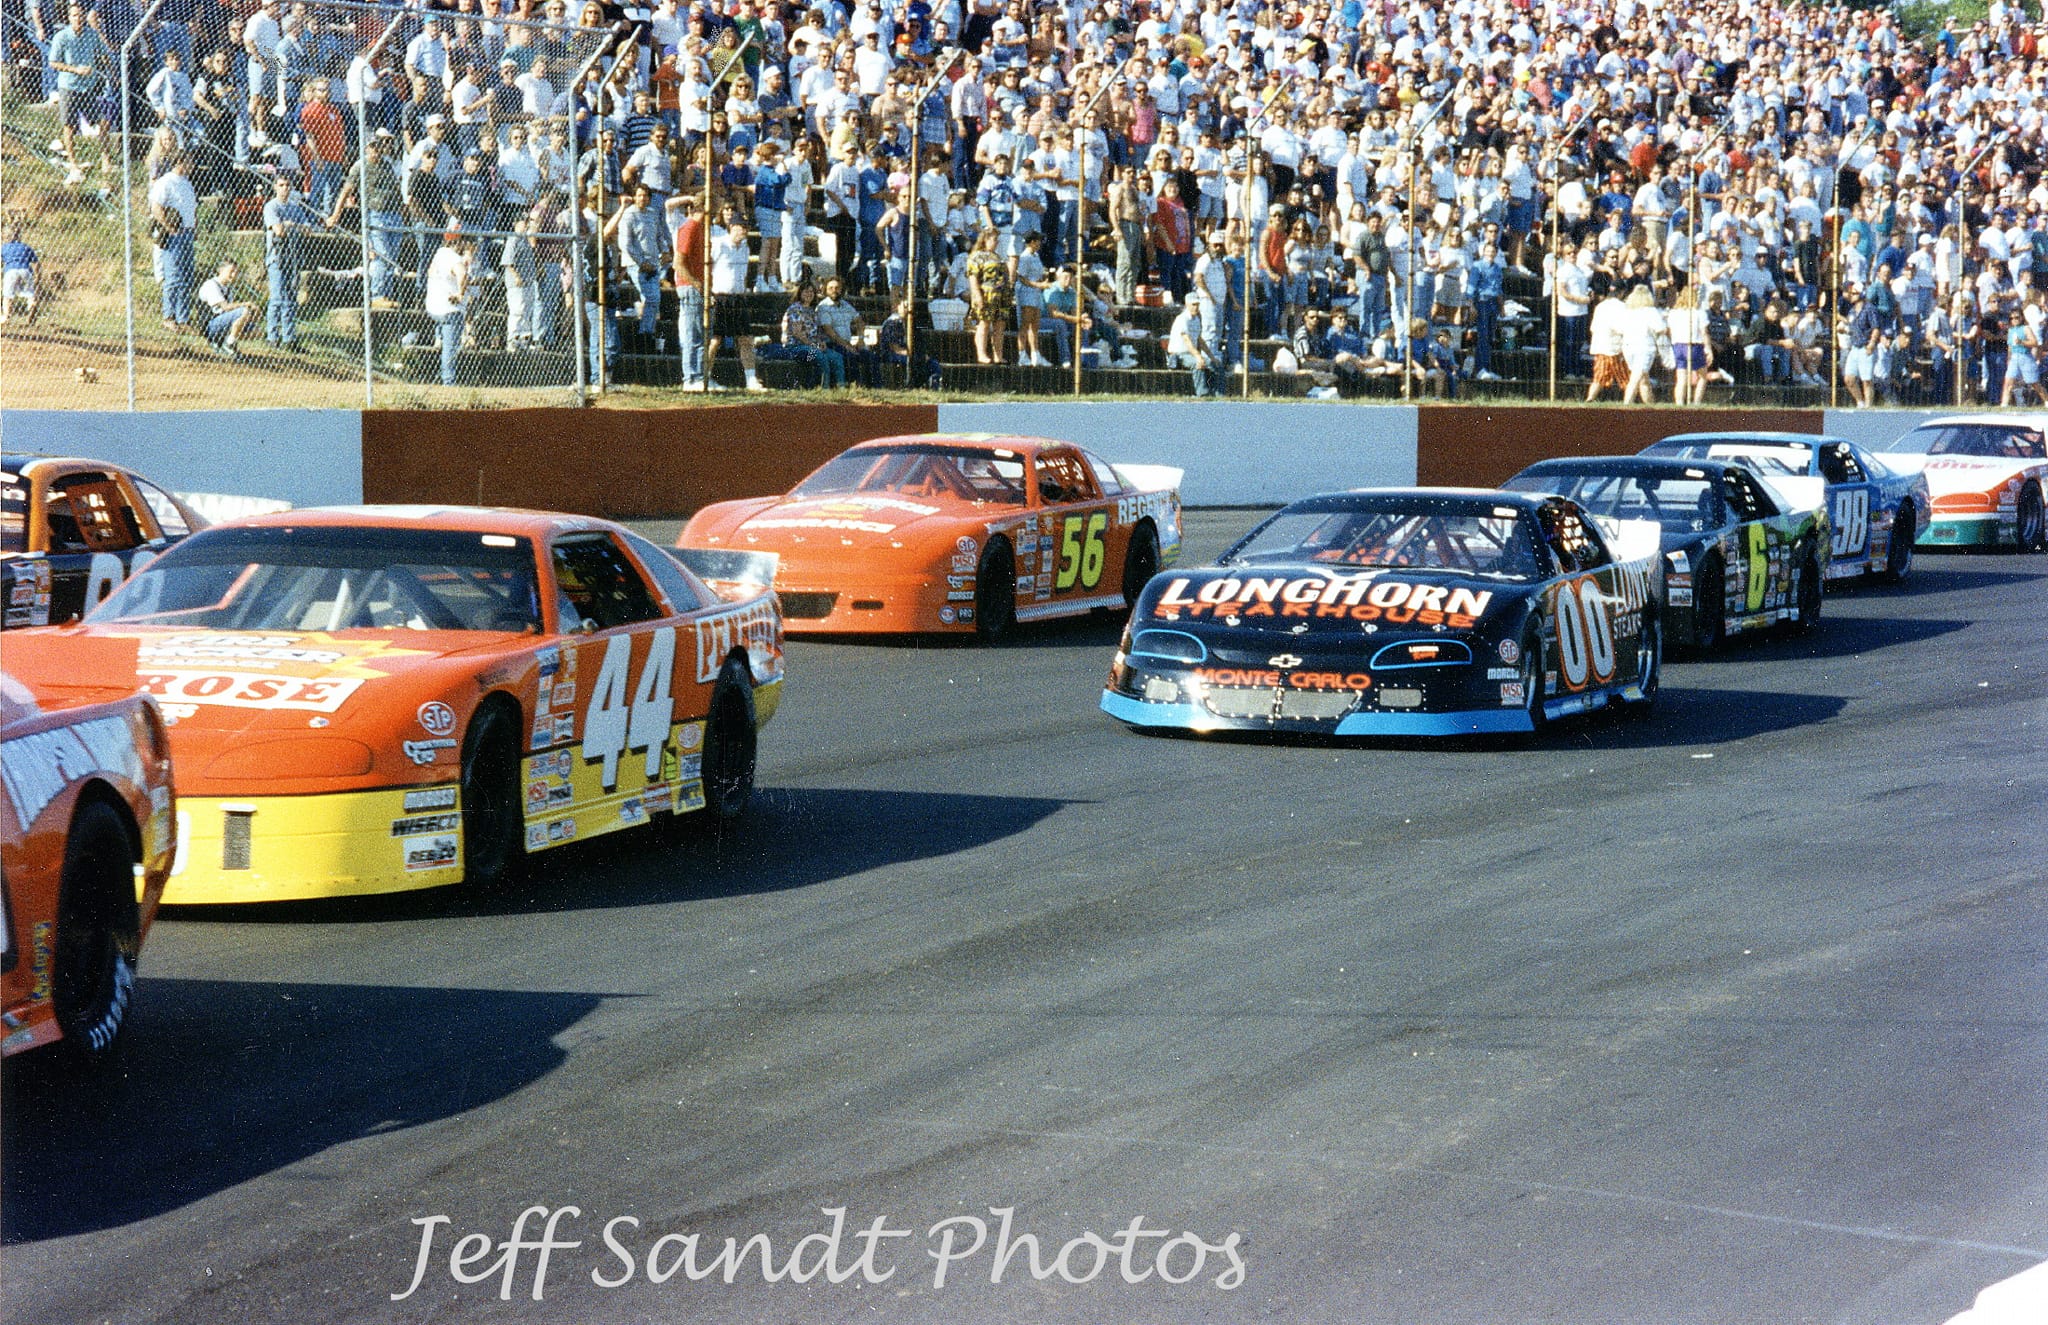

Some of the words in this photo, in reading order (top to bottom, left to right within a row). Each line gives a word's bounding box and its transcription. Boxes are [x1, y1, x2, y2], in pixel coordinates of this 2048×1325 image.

[1832, 489, 1869, 556] 98
[1056, 512, 1107, 589] 56
[1747, 522, 1767, 612] 6
[1154, 601, 1478, 628] STEAKHOUSE
[1159, 578, 1493, 617] LONGHORN
[1555, 576, 1616, 690] 00
[1194, 668, 1281, 686] MONTE
[1288, 670, 1372, 690] CARLO
[1502, 684, 1522, 696] MSD
[422, 703, 453, 731] STP
[582, 626, 677, 790] 44
